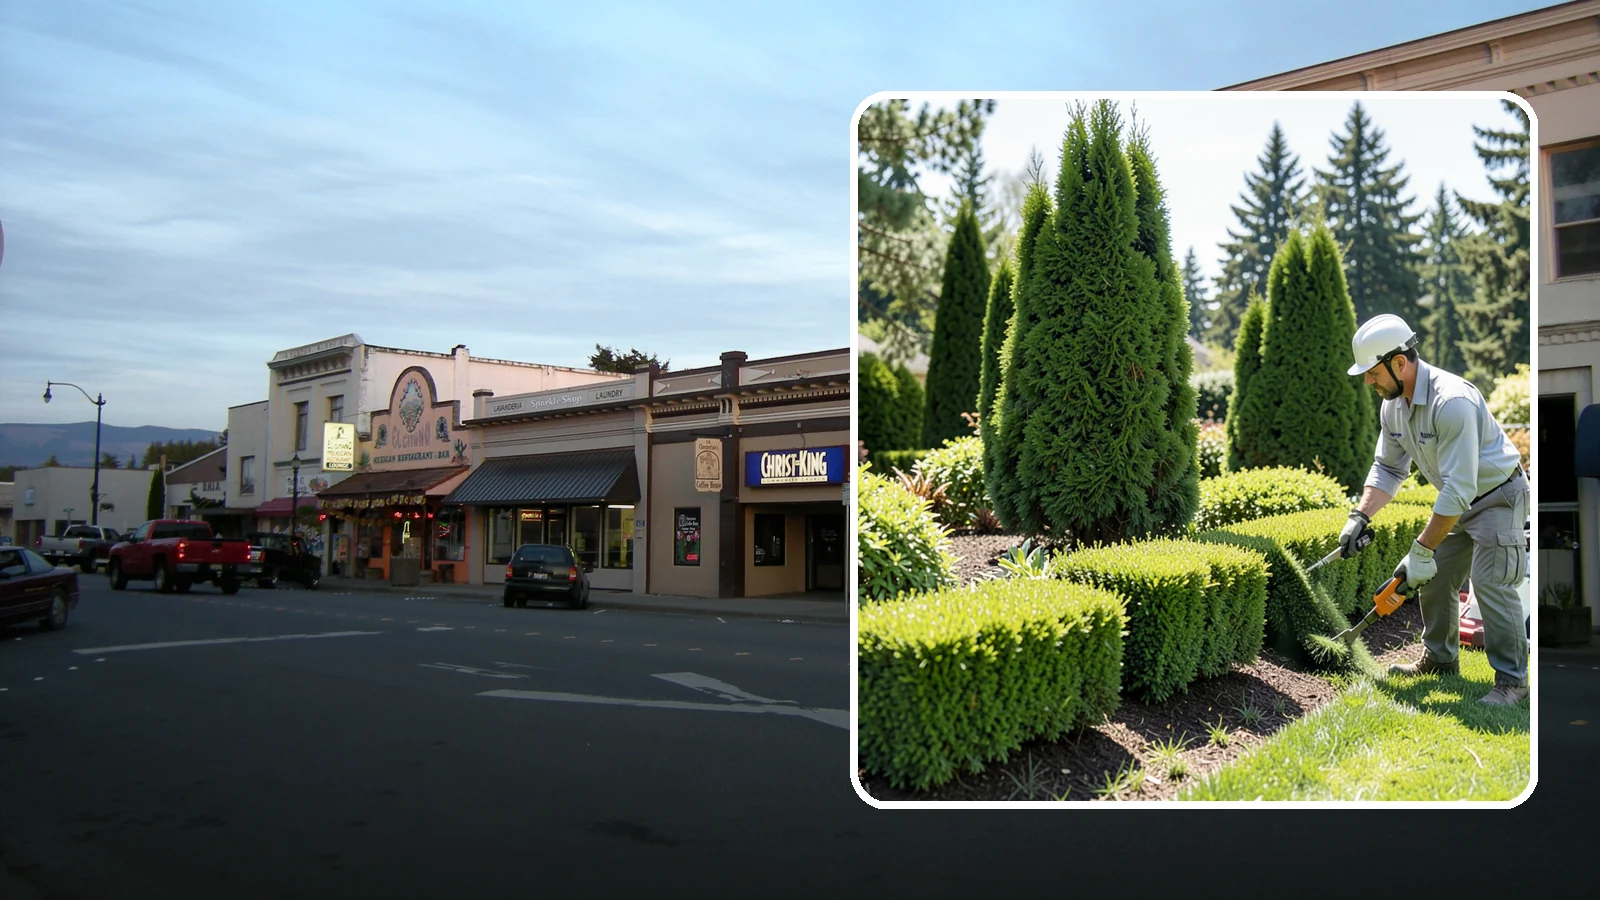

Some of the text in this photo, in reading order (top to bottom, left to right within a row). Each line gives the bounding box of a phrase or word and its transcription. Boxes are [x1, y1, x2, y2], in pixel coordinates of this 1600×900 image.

[531, 394, 583, 409] Sparkle Shop
[595, 389, 624, 400] LAUNDRY
[493, 402, 523, 413] LAVANDERIA
[373, 455, 396, 465] MEXICAN
[397, 451, 434, 461] RESTAURANT
[437, 449, 450, 459] BAR
[760, 450, 828, 478] CHRIST KING
